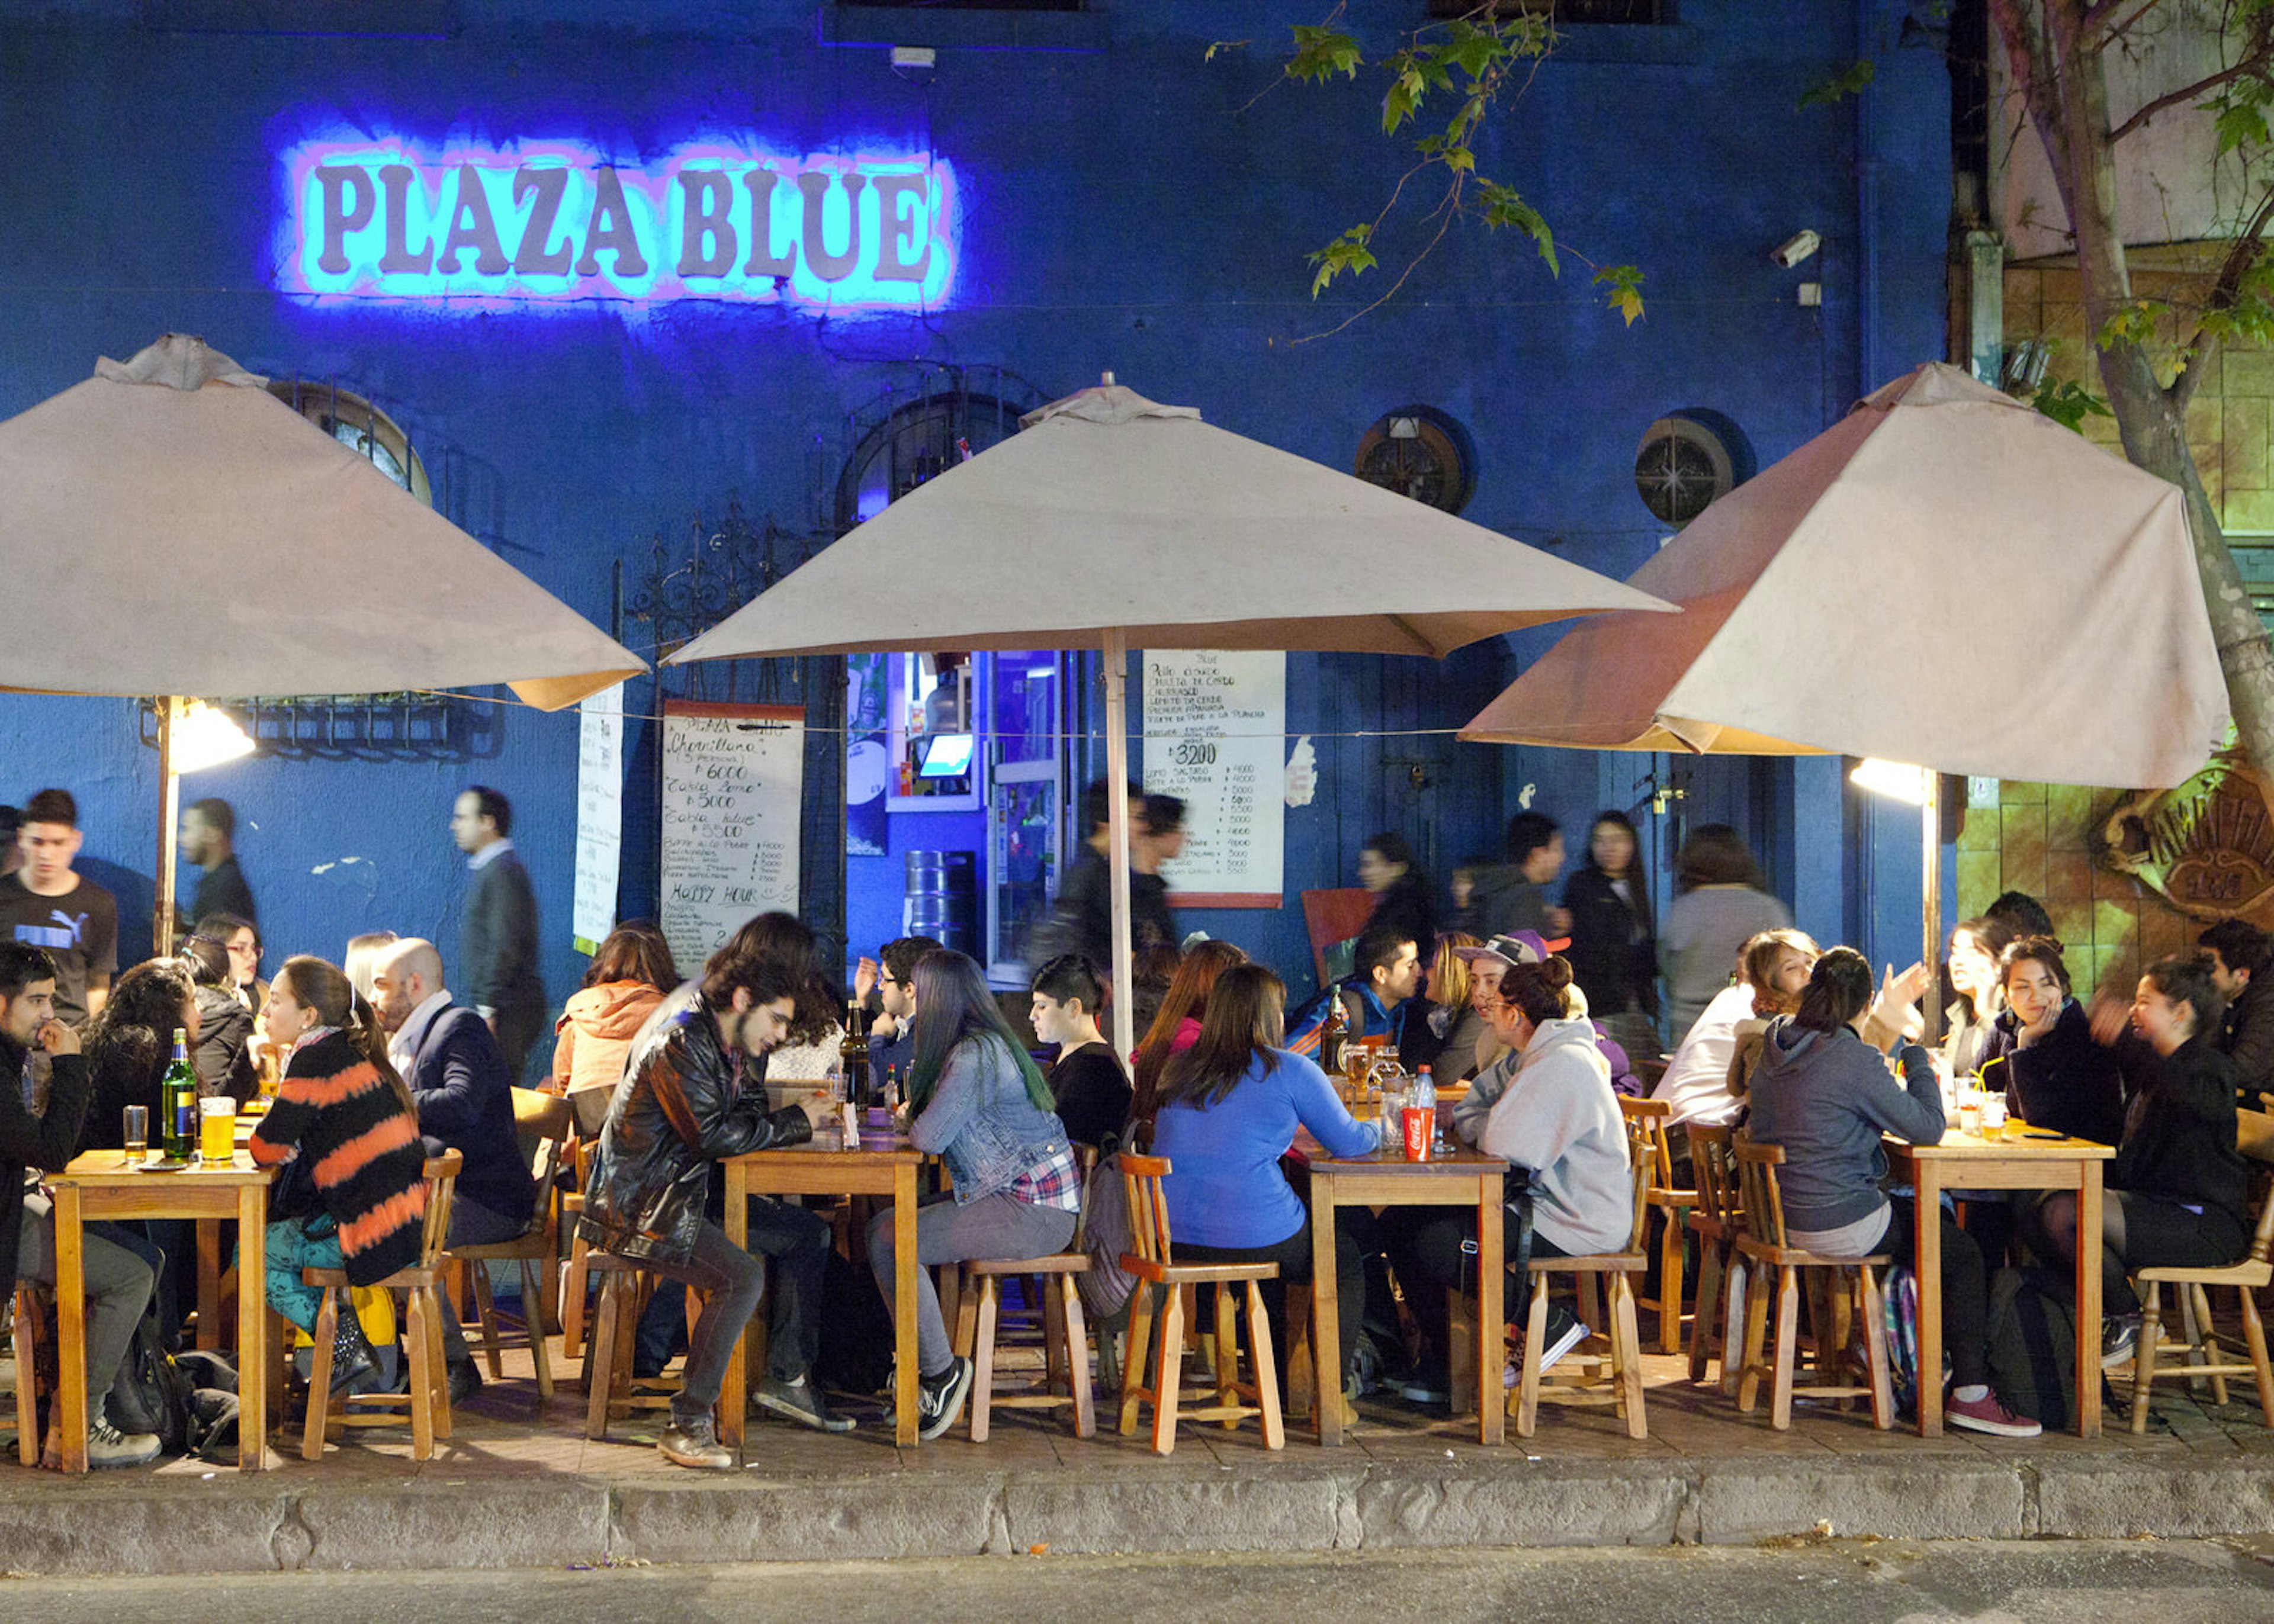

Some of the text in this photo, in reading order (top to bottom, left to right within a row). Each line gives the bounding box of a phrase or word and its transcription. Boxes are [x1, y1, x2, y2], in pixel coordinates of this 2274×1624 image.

[314, 163, 932, 281] PLAZA BLUE
[1175, 743, 1216, 765] 3200
